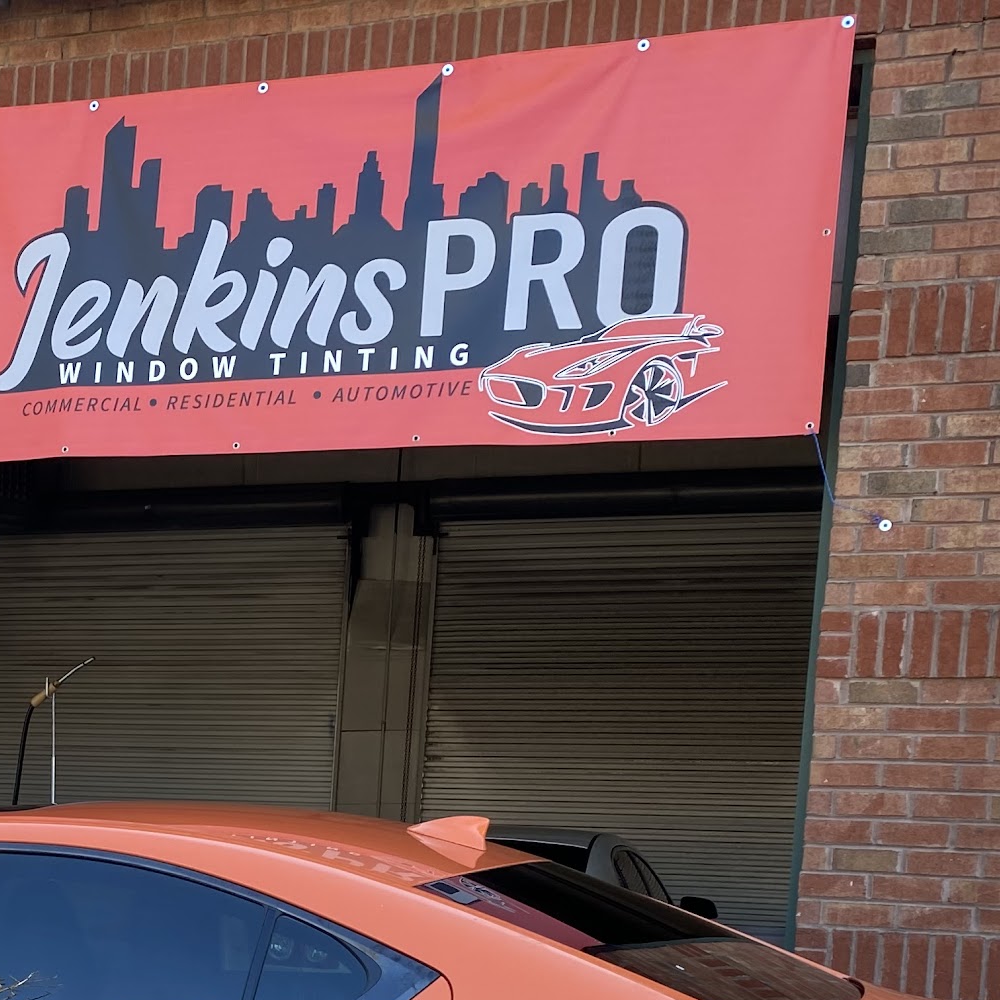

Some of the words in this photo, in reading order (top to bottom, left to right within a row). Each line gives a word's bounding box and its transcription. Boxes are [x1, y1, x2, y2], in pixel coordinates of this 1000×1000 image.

[419, 206, 685, 337] PRO
[58, 355, 237, 385] WINDOW
[269, 342, 470, 376] TINTING
[22, 396, 143, 417] COMMERCIAL
[166, 389, 297, 410] RESIDENTIAL
[332, 380, 474, 404] AUTOMOTIVE
